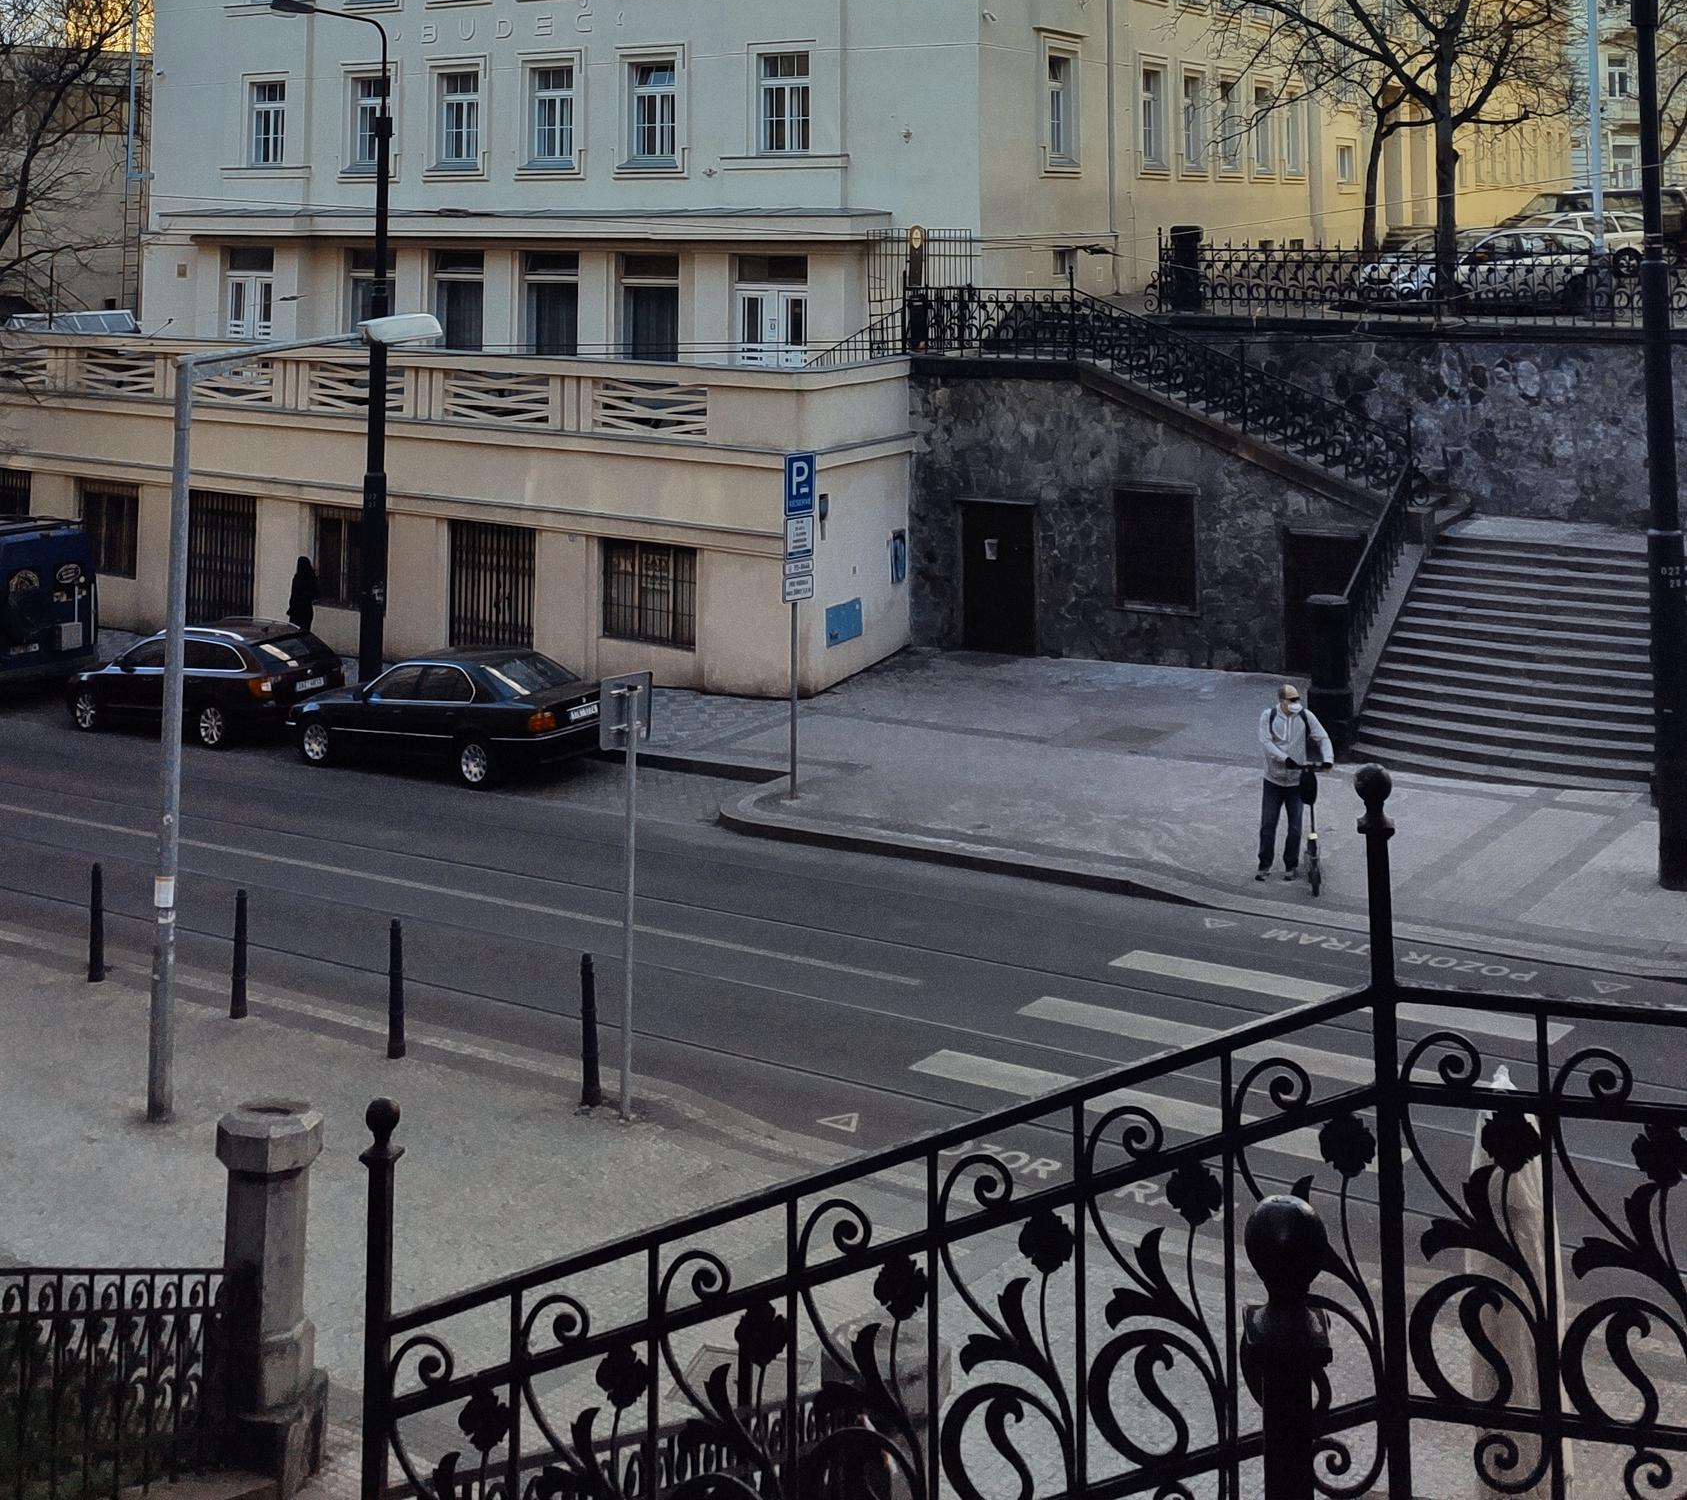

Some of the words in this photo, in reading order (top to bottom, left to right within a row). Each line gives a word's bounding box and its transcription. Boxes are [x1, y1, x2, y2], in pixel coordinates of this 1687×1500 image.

[792, 461, 809, 496] P
[1260, 929, 1370, 956] TRAM
[1401, 951, 1538, 982] POZOR
